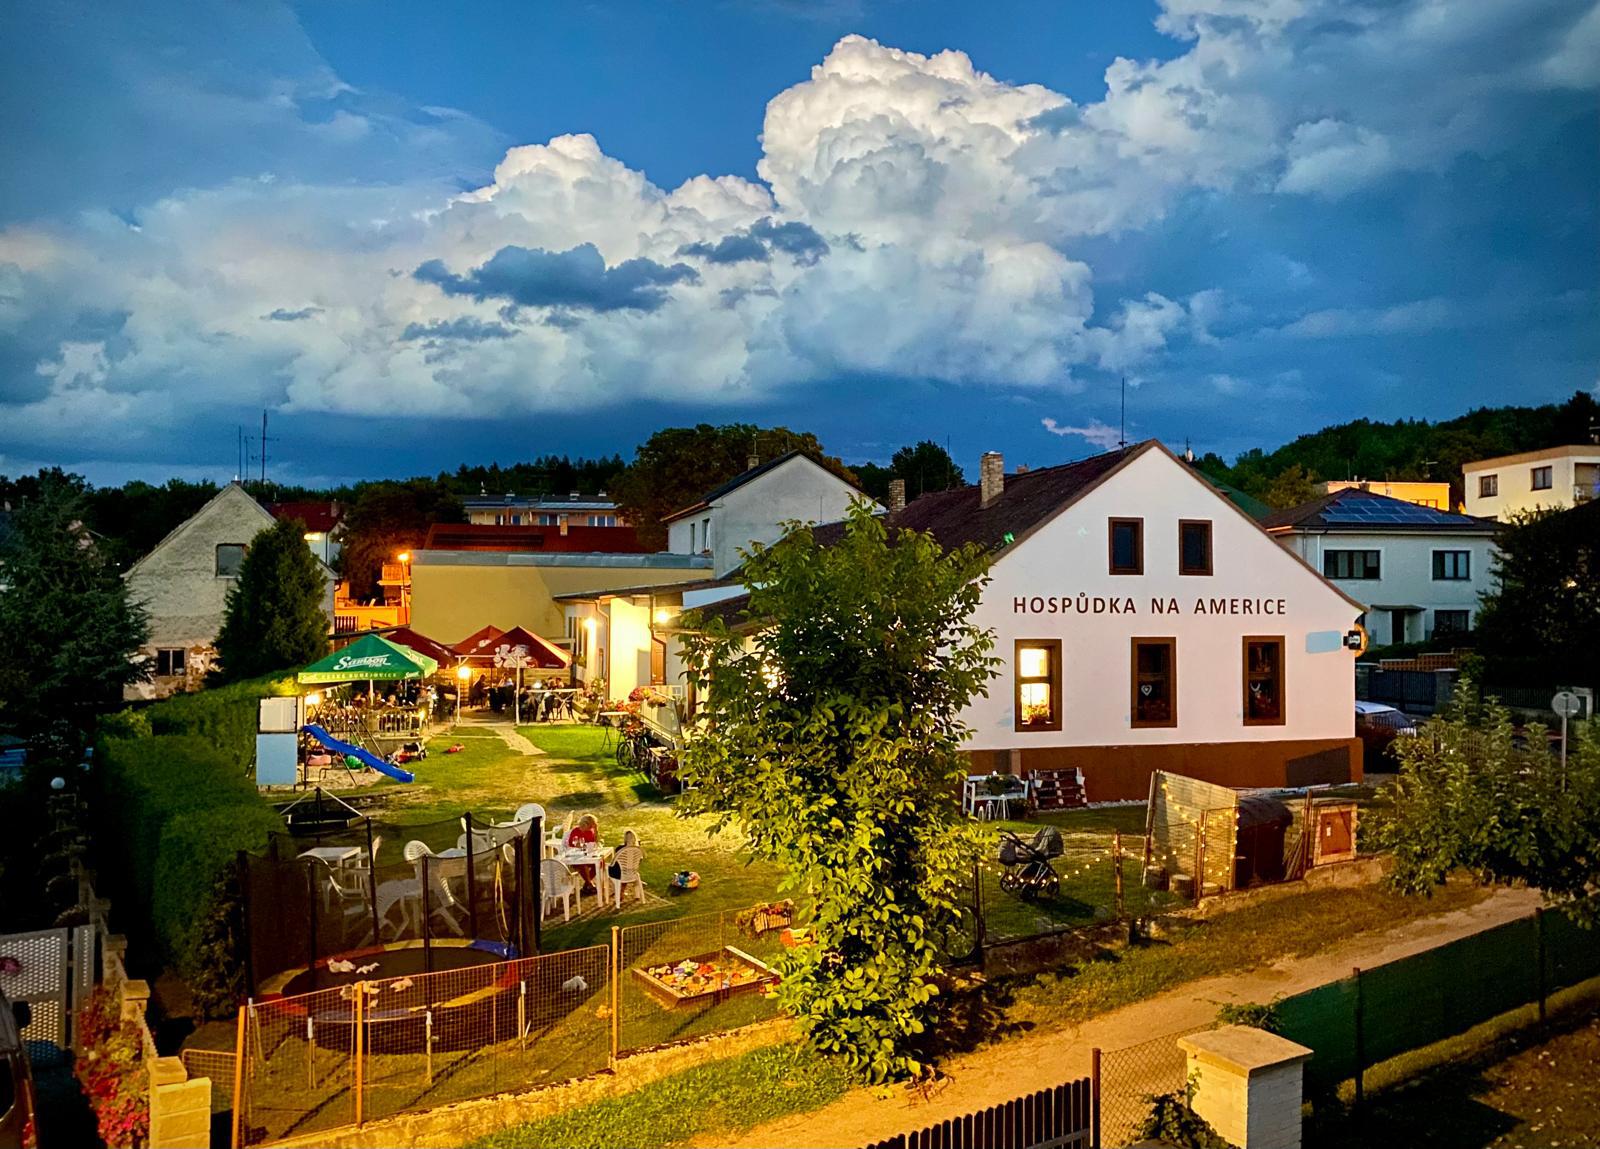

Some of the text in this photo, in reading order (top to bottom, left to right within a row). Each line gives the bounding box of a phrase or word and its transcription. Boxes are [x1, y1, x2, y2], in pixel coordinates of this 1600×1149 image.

[1013, 592, 1286, 615] HOSPŮDKA NA AMERICE
[333, 653, 392, 671] Samson
